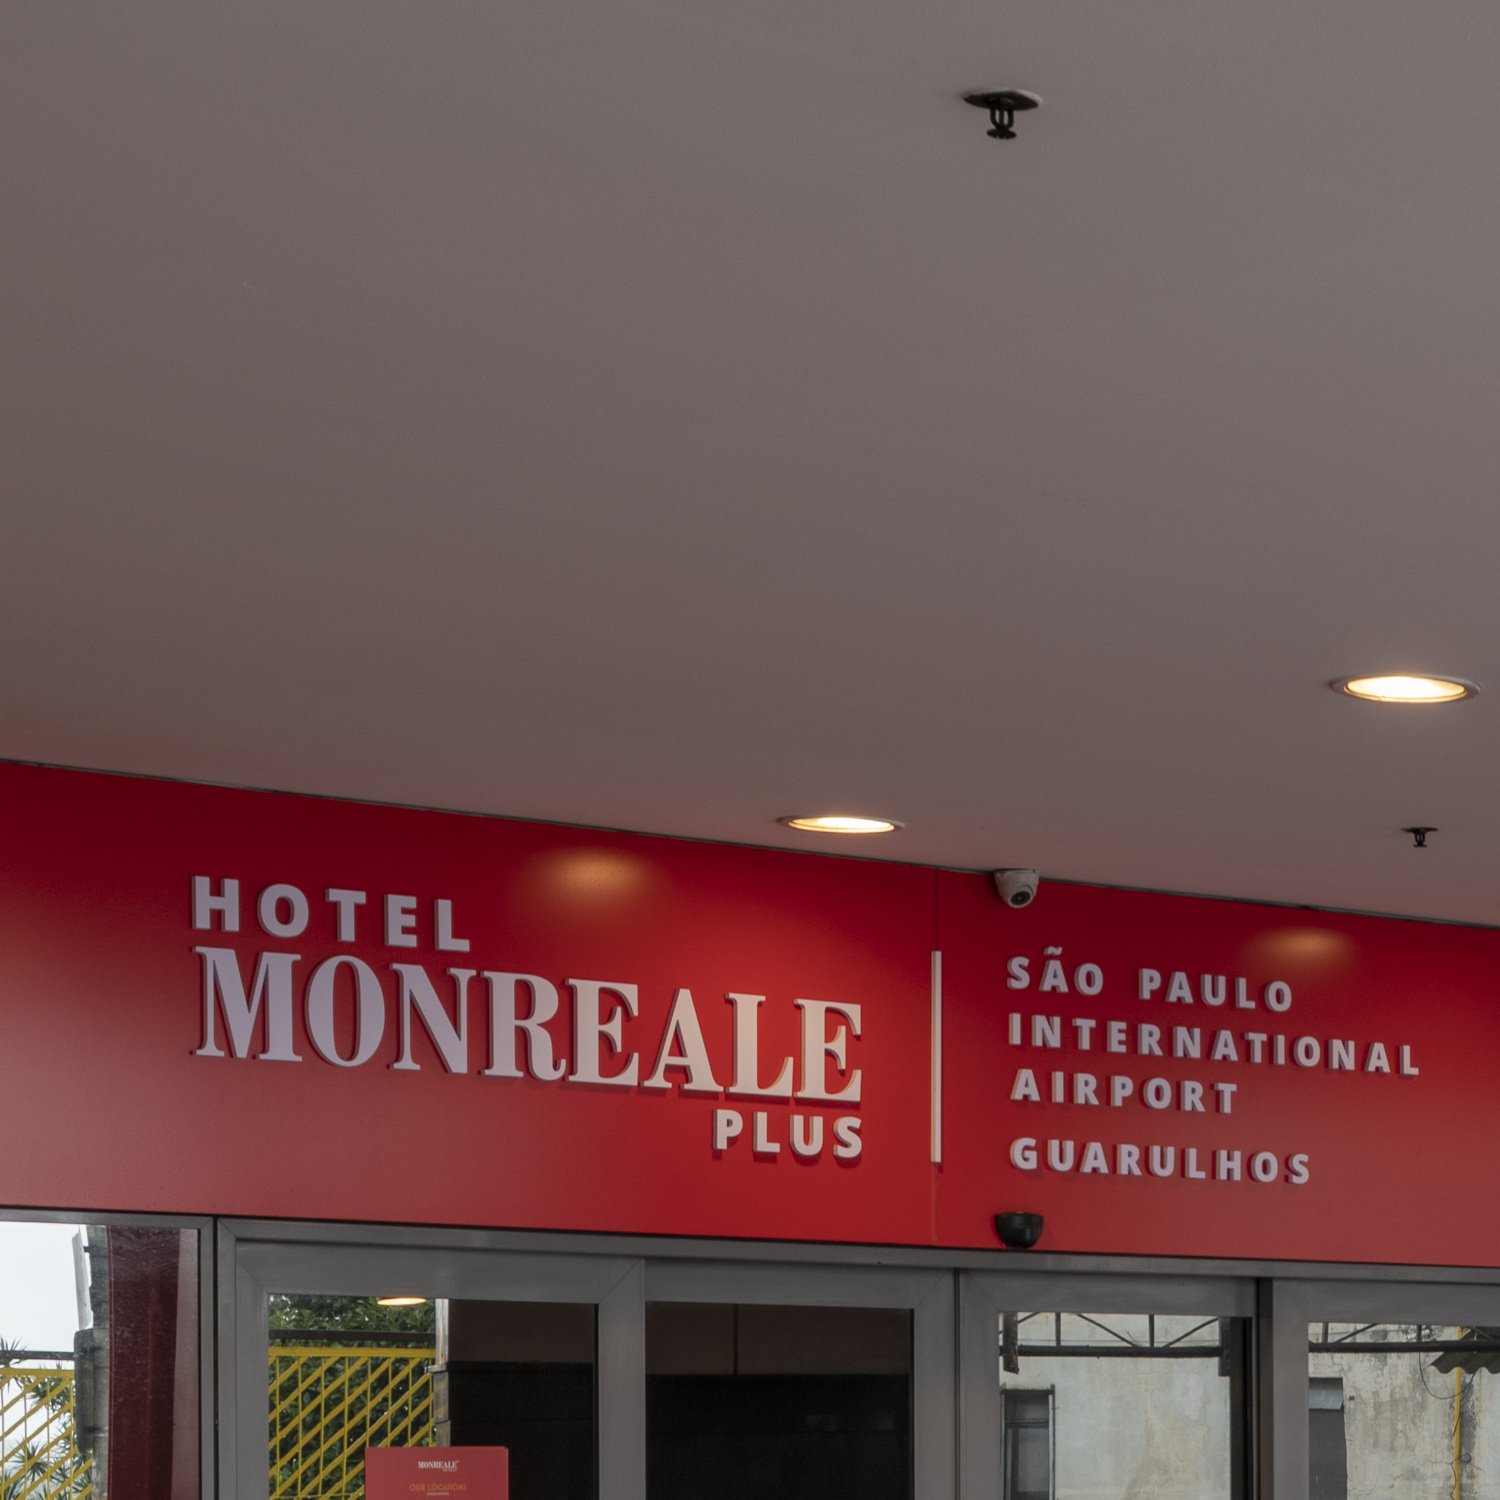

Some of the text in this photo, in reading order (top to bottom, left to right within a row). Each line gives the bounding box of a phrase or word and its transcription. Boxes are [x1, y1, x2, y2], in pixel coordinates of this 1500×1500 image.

[192, 876, 470, 952] HOTEL
[1007, 946, 1292, 1013] SÃO PAULO
[193, 946, 861, 1102] MONREALE
[1008, 1013, 1420, 1076] INTERNATIONAL
[1010, 1068, 1238, 1114] AIRPORT
[712, 1108, 862, 1159] PLUS
[1009, 1137, 1311, 1185] GUARULHOS
[418, 1461, 457, 1469] MONREALE
